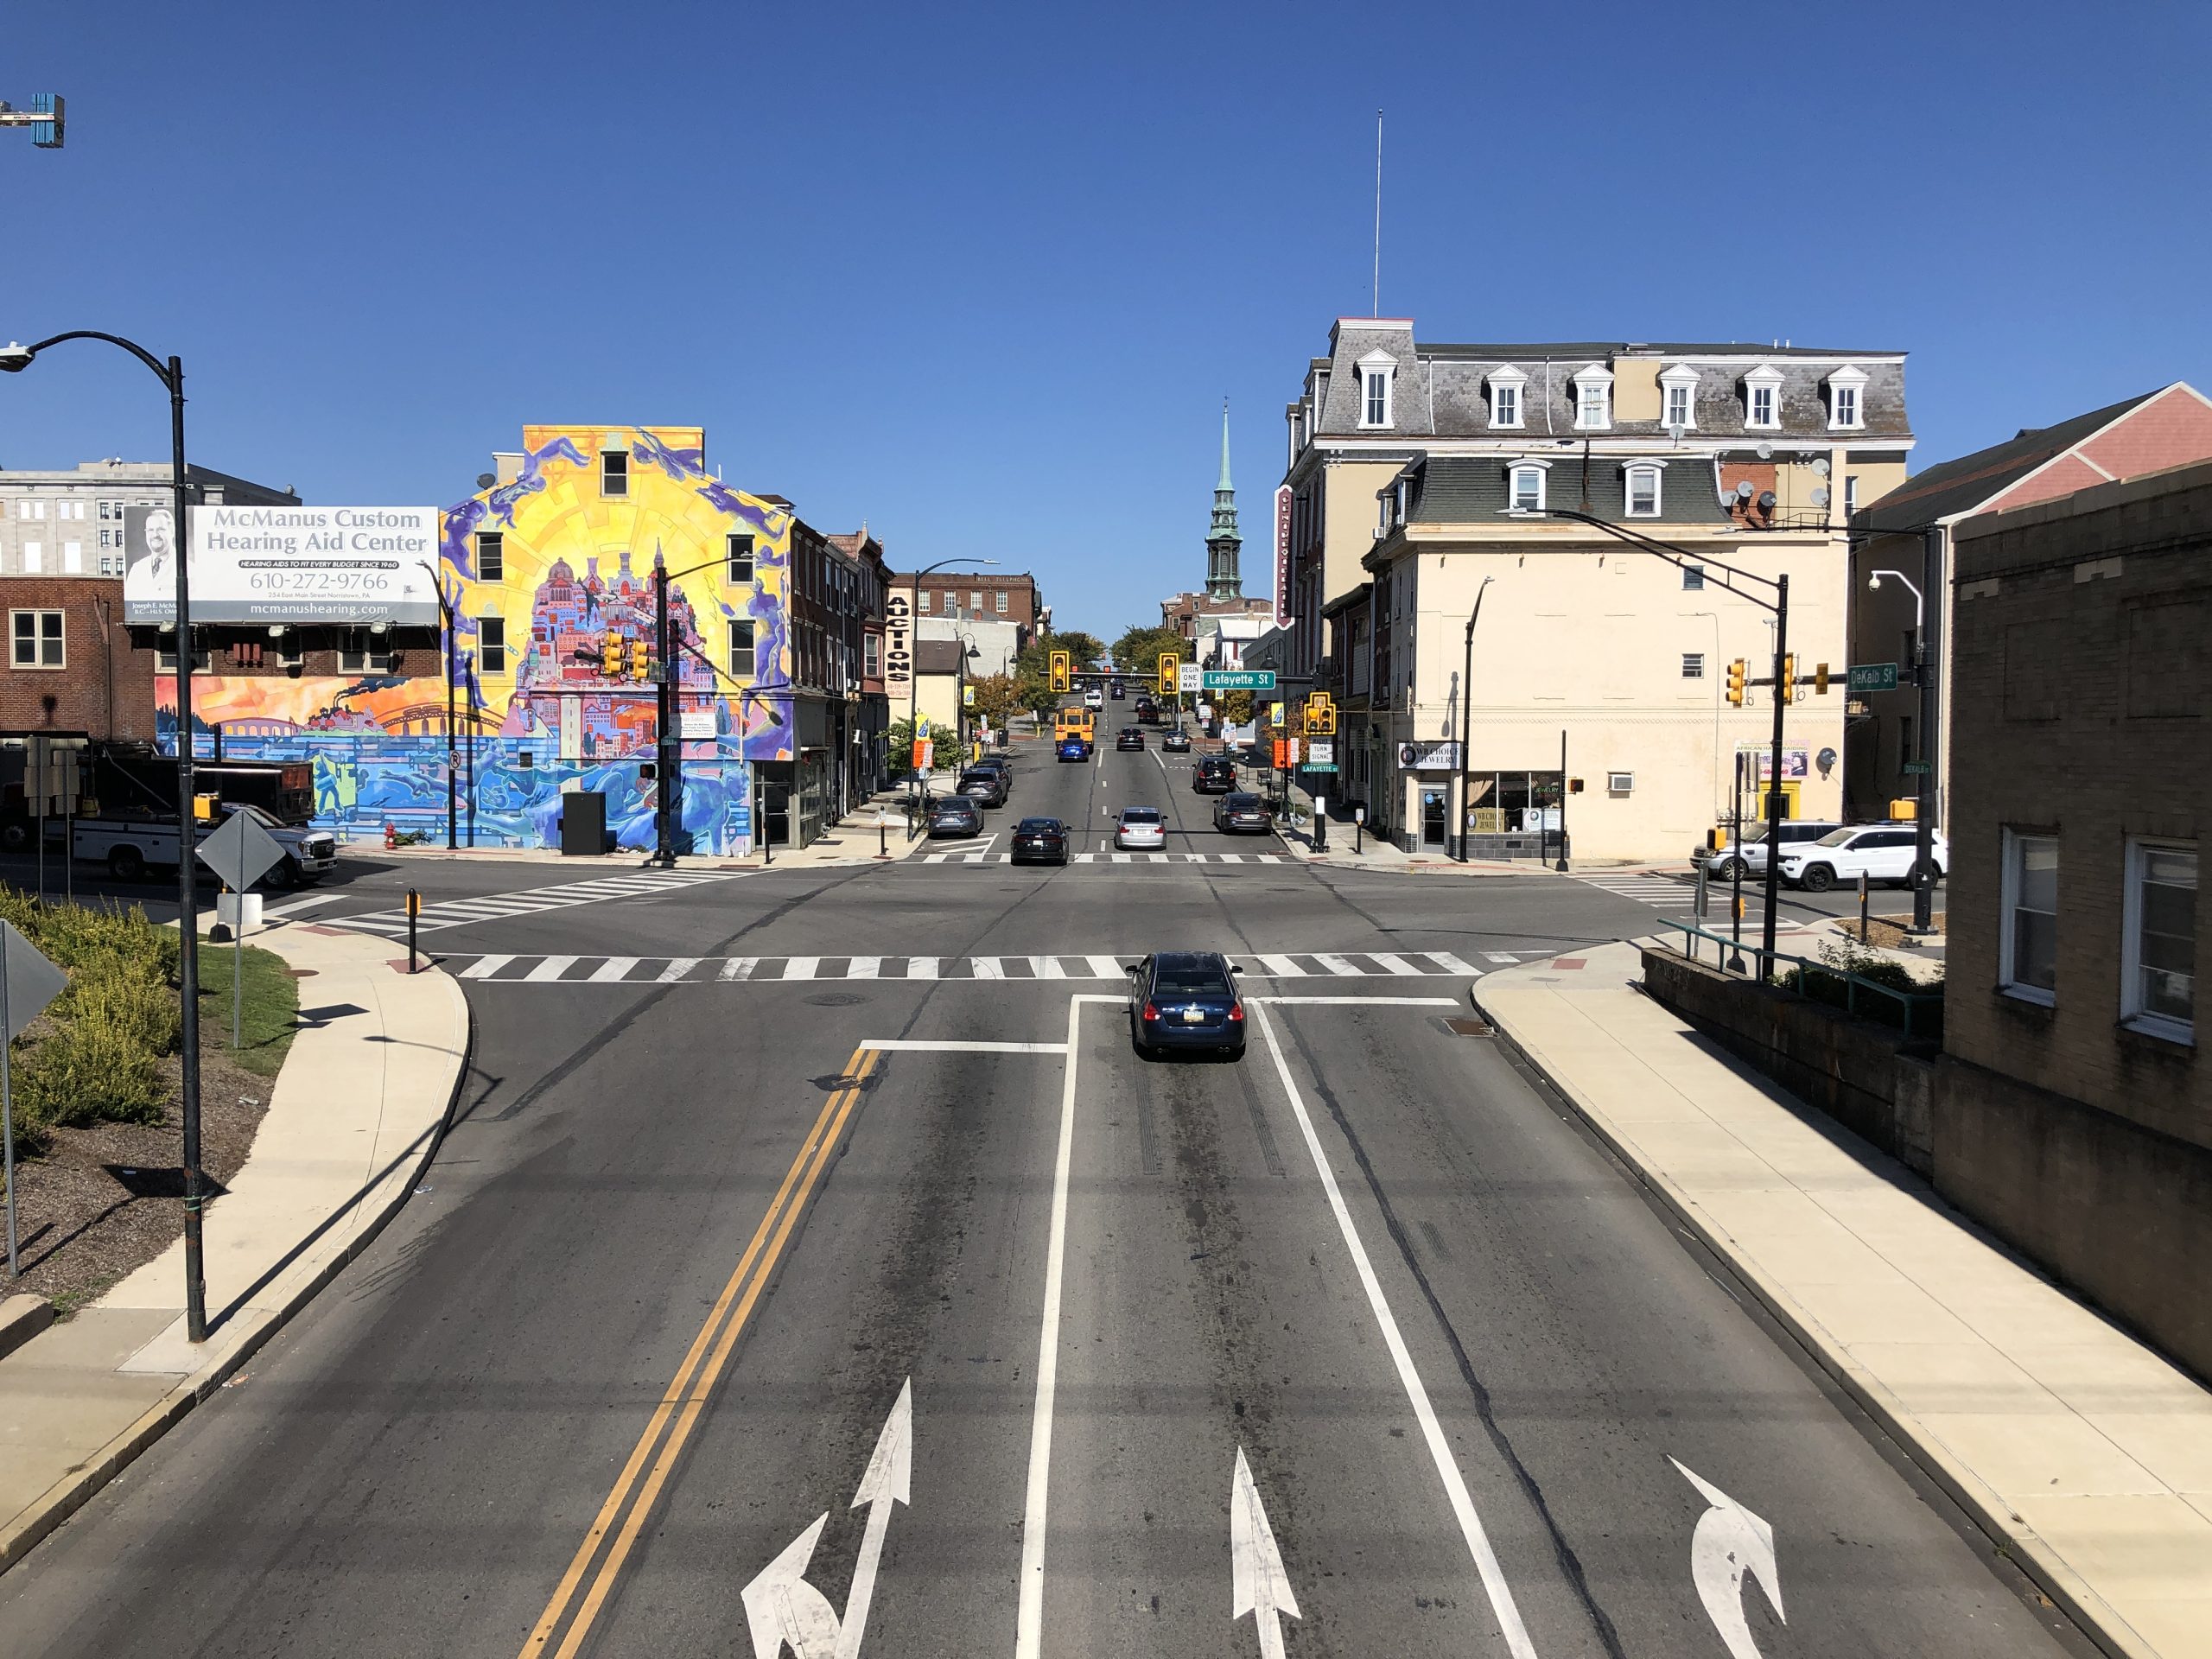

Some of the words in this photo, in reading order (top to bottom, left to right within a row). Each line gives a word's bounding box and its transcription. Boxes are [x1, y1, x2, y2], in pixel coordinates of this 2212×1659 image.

[214, 509, 327, 527] McManus
[334, 509, 421, 528] Custom
[207, 531, 297, 555] Hearing
[305, 531, 343, 551] Aid
[351, 532, 427, 551] Center
[250, 573, 388, 589] 610-272-9766
[251, 602, 388, 615] mcmanushearing.com
[887, 596, 910, 682] AUCTIONS
[1209, 674, 1254, 687] Lafayette
[1258, 674, 1268, 684] St
[1851, 670, 1880, 685] DeKalb
[1884, 668, 1893, 683] St
